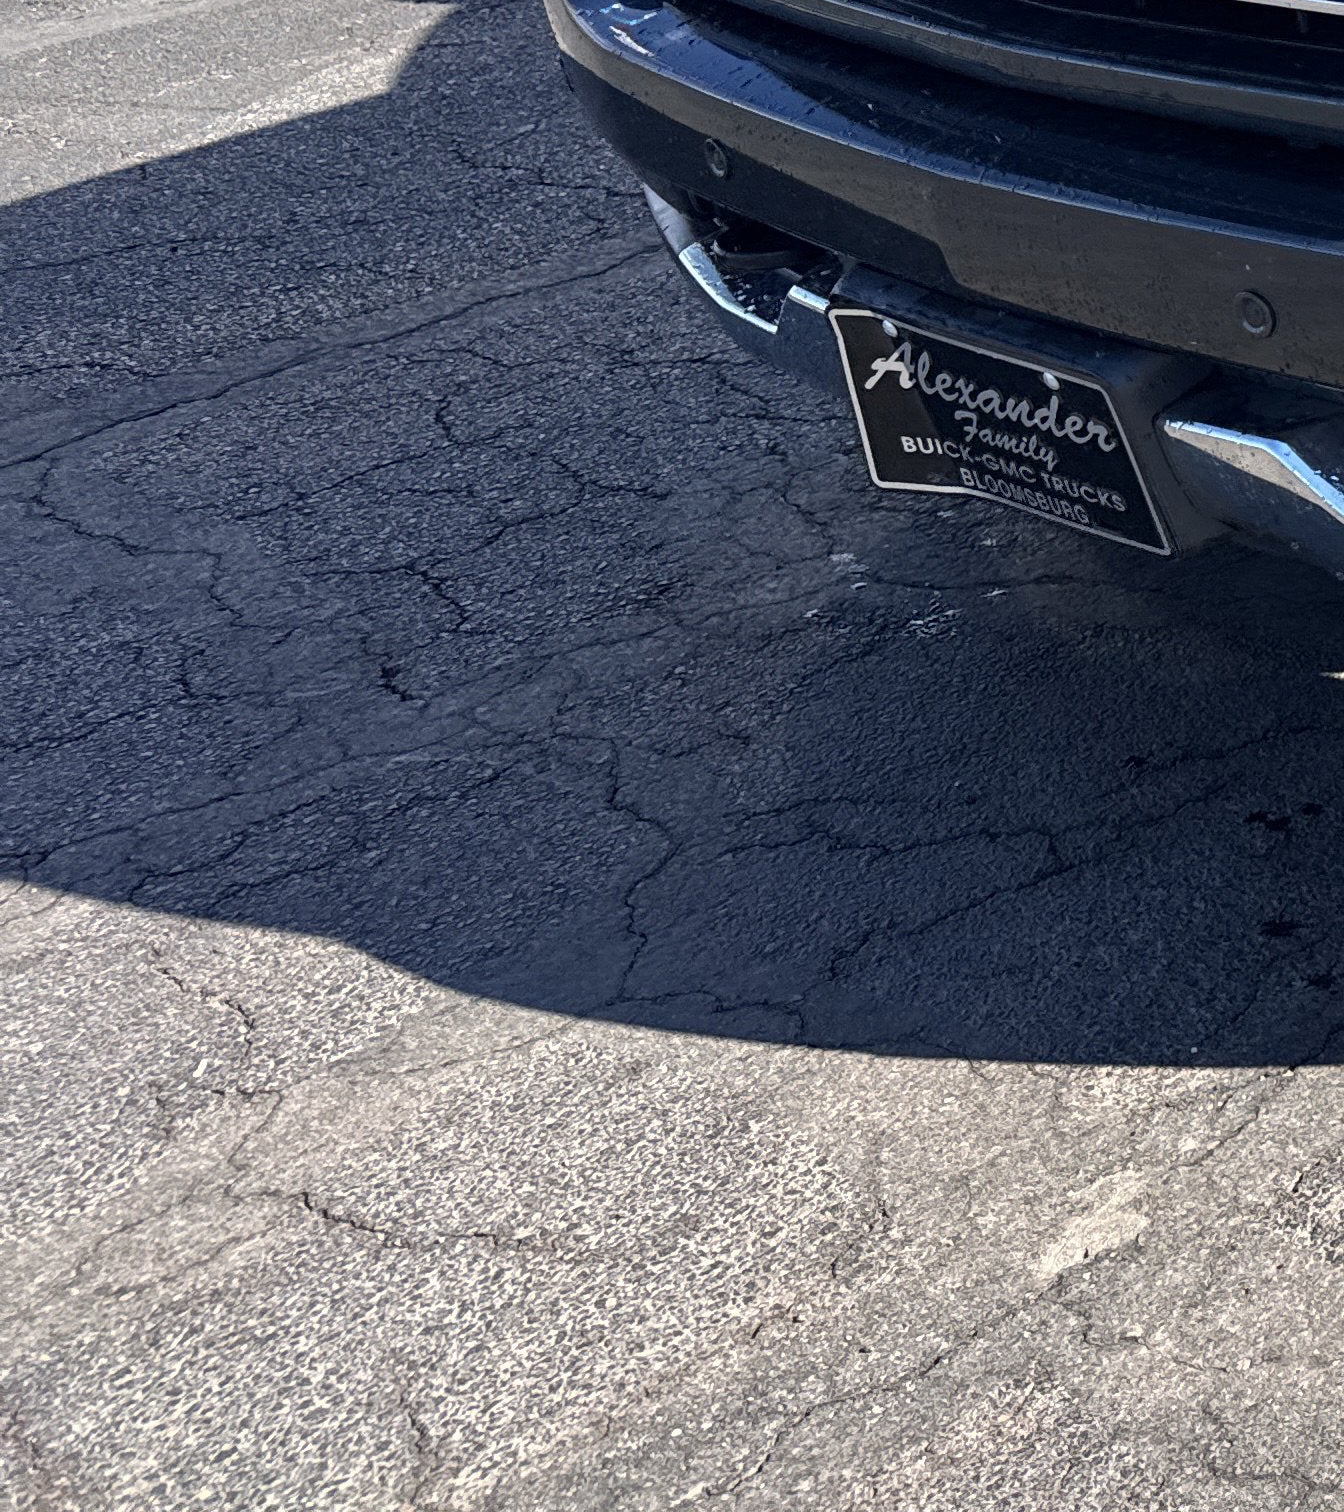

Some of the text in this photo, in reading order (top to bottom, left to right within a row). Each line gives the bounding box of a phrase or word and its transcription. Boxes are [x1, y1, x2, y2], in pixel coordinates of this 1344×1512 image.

[865, 342, 1116, 452] Alexander
[954, 409, 1058, 470] Family
[959, 467, 1090, 524] BLOOMSBURG
[1041, 471, 1127, 512] TRUCKS
